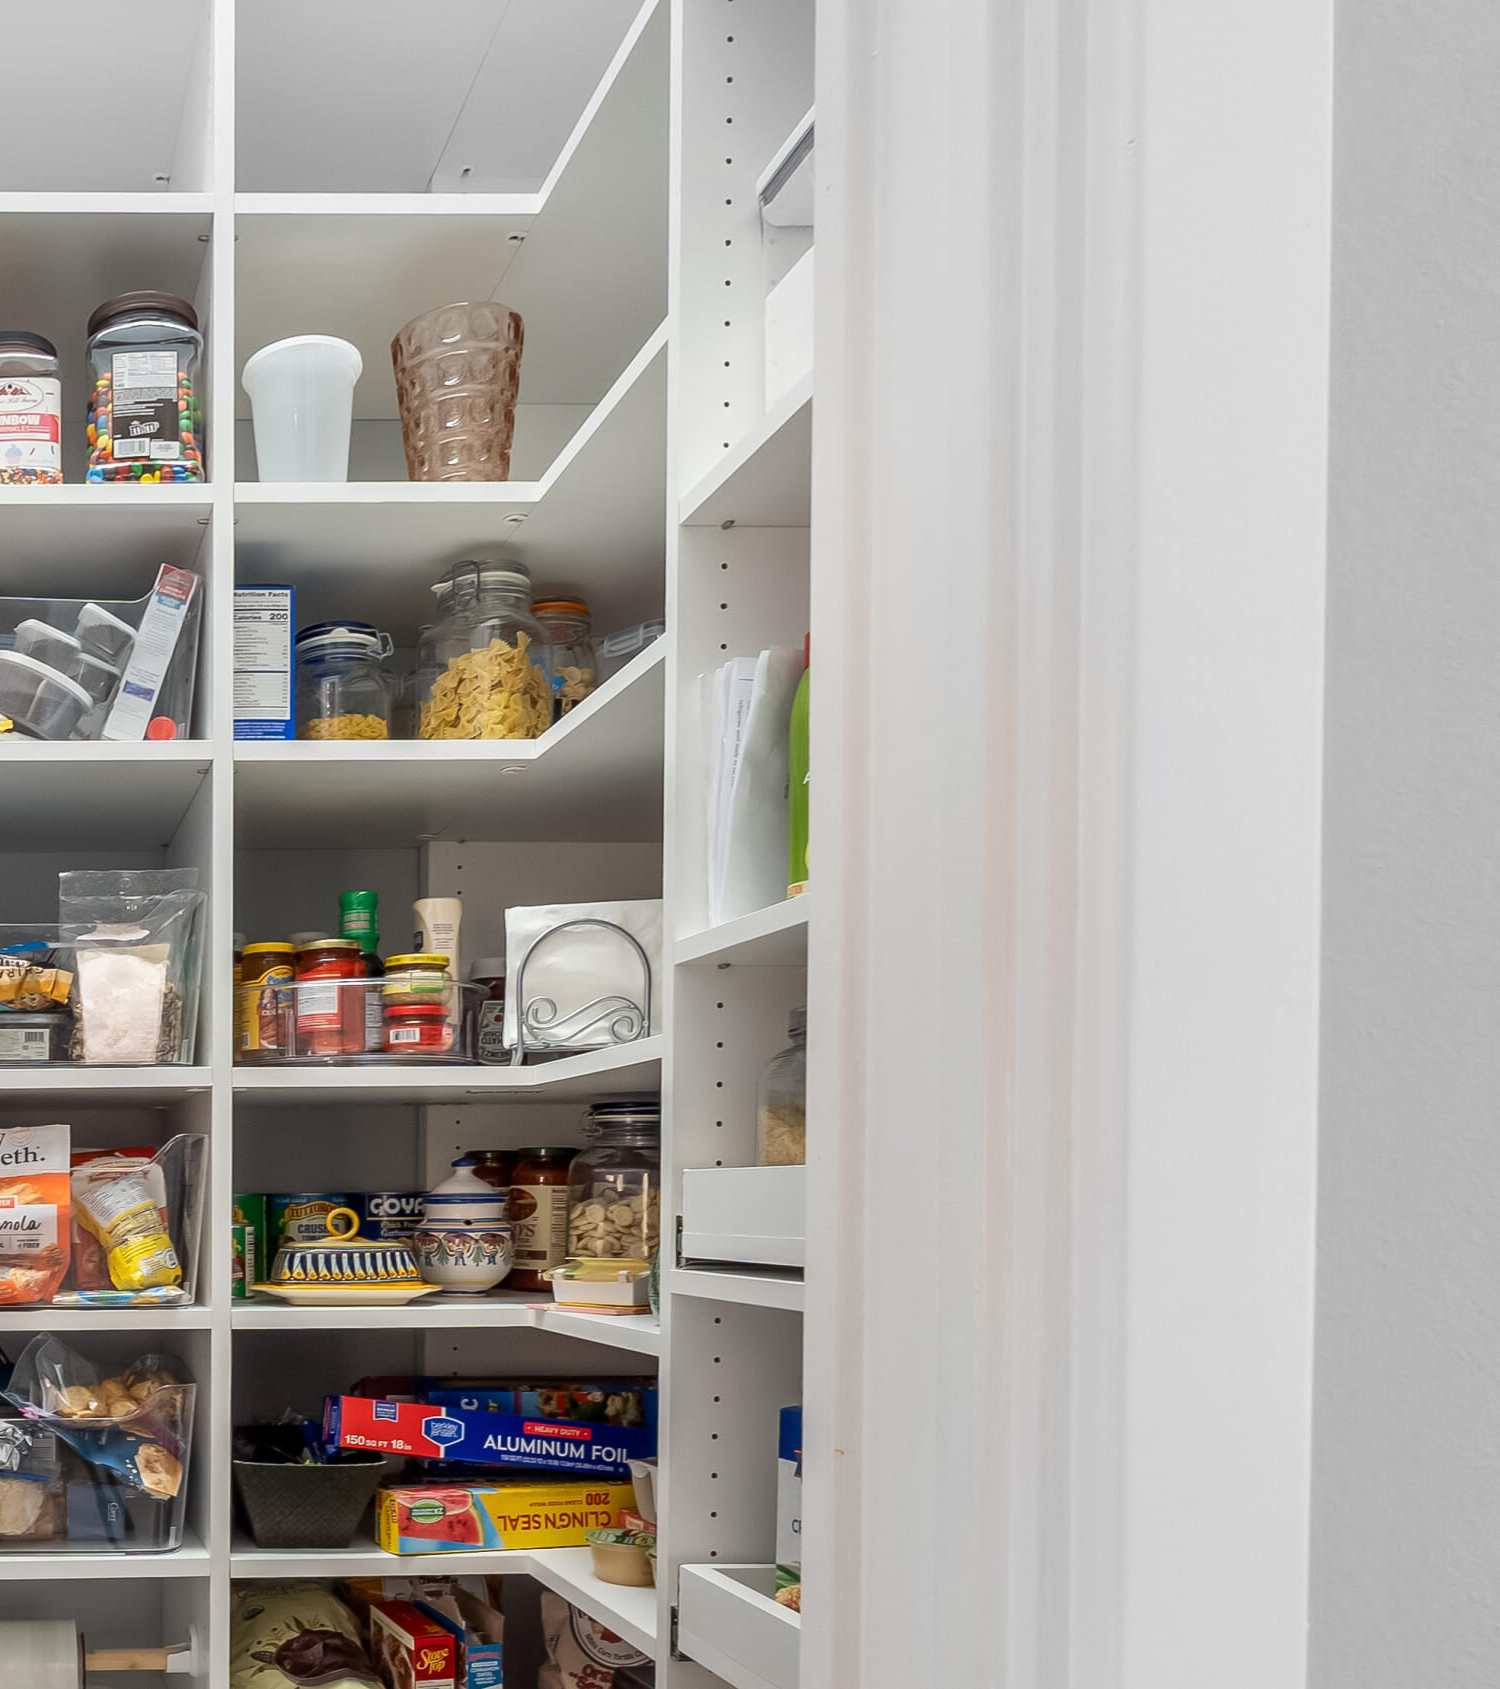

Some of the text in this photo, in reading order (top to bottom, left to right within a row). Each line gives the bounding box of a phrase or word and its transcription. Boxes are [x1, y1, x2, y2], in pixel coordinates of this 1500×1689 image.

[268, 612, 288, 620] 200
[533, 1425, 581, 1437] HEAVY DUTY
[483, 1434, 585, 1459] ALUMINUM
[591, 1446, 629, 1464] FOIL
[586, 1493, 610, 1506] 200
[499, 1513, 541, 1532] SEAL
[416, 1648, 449, 1670] Stove
[427, 1661, 446, 1675] Top
